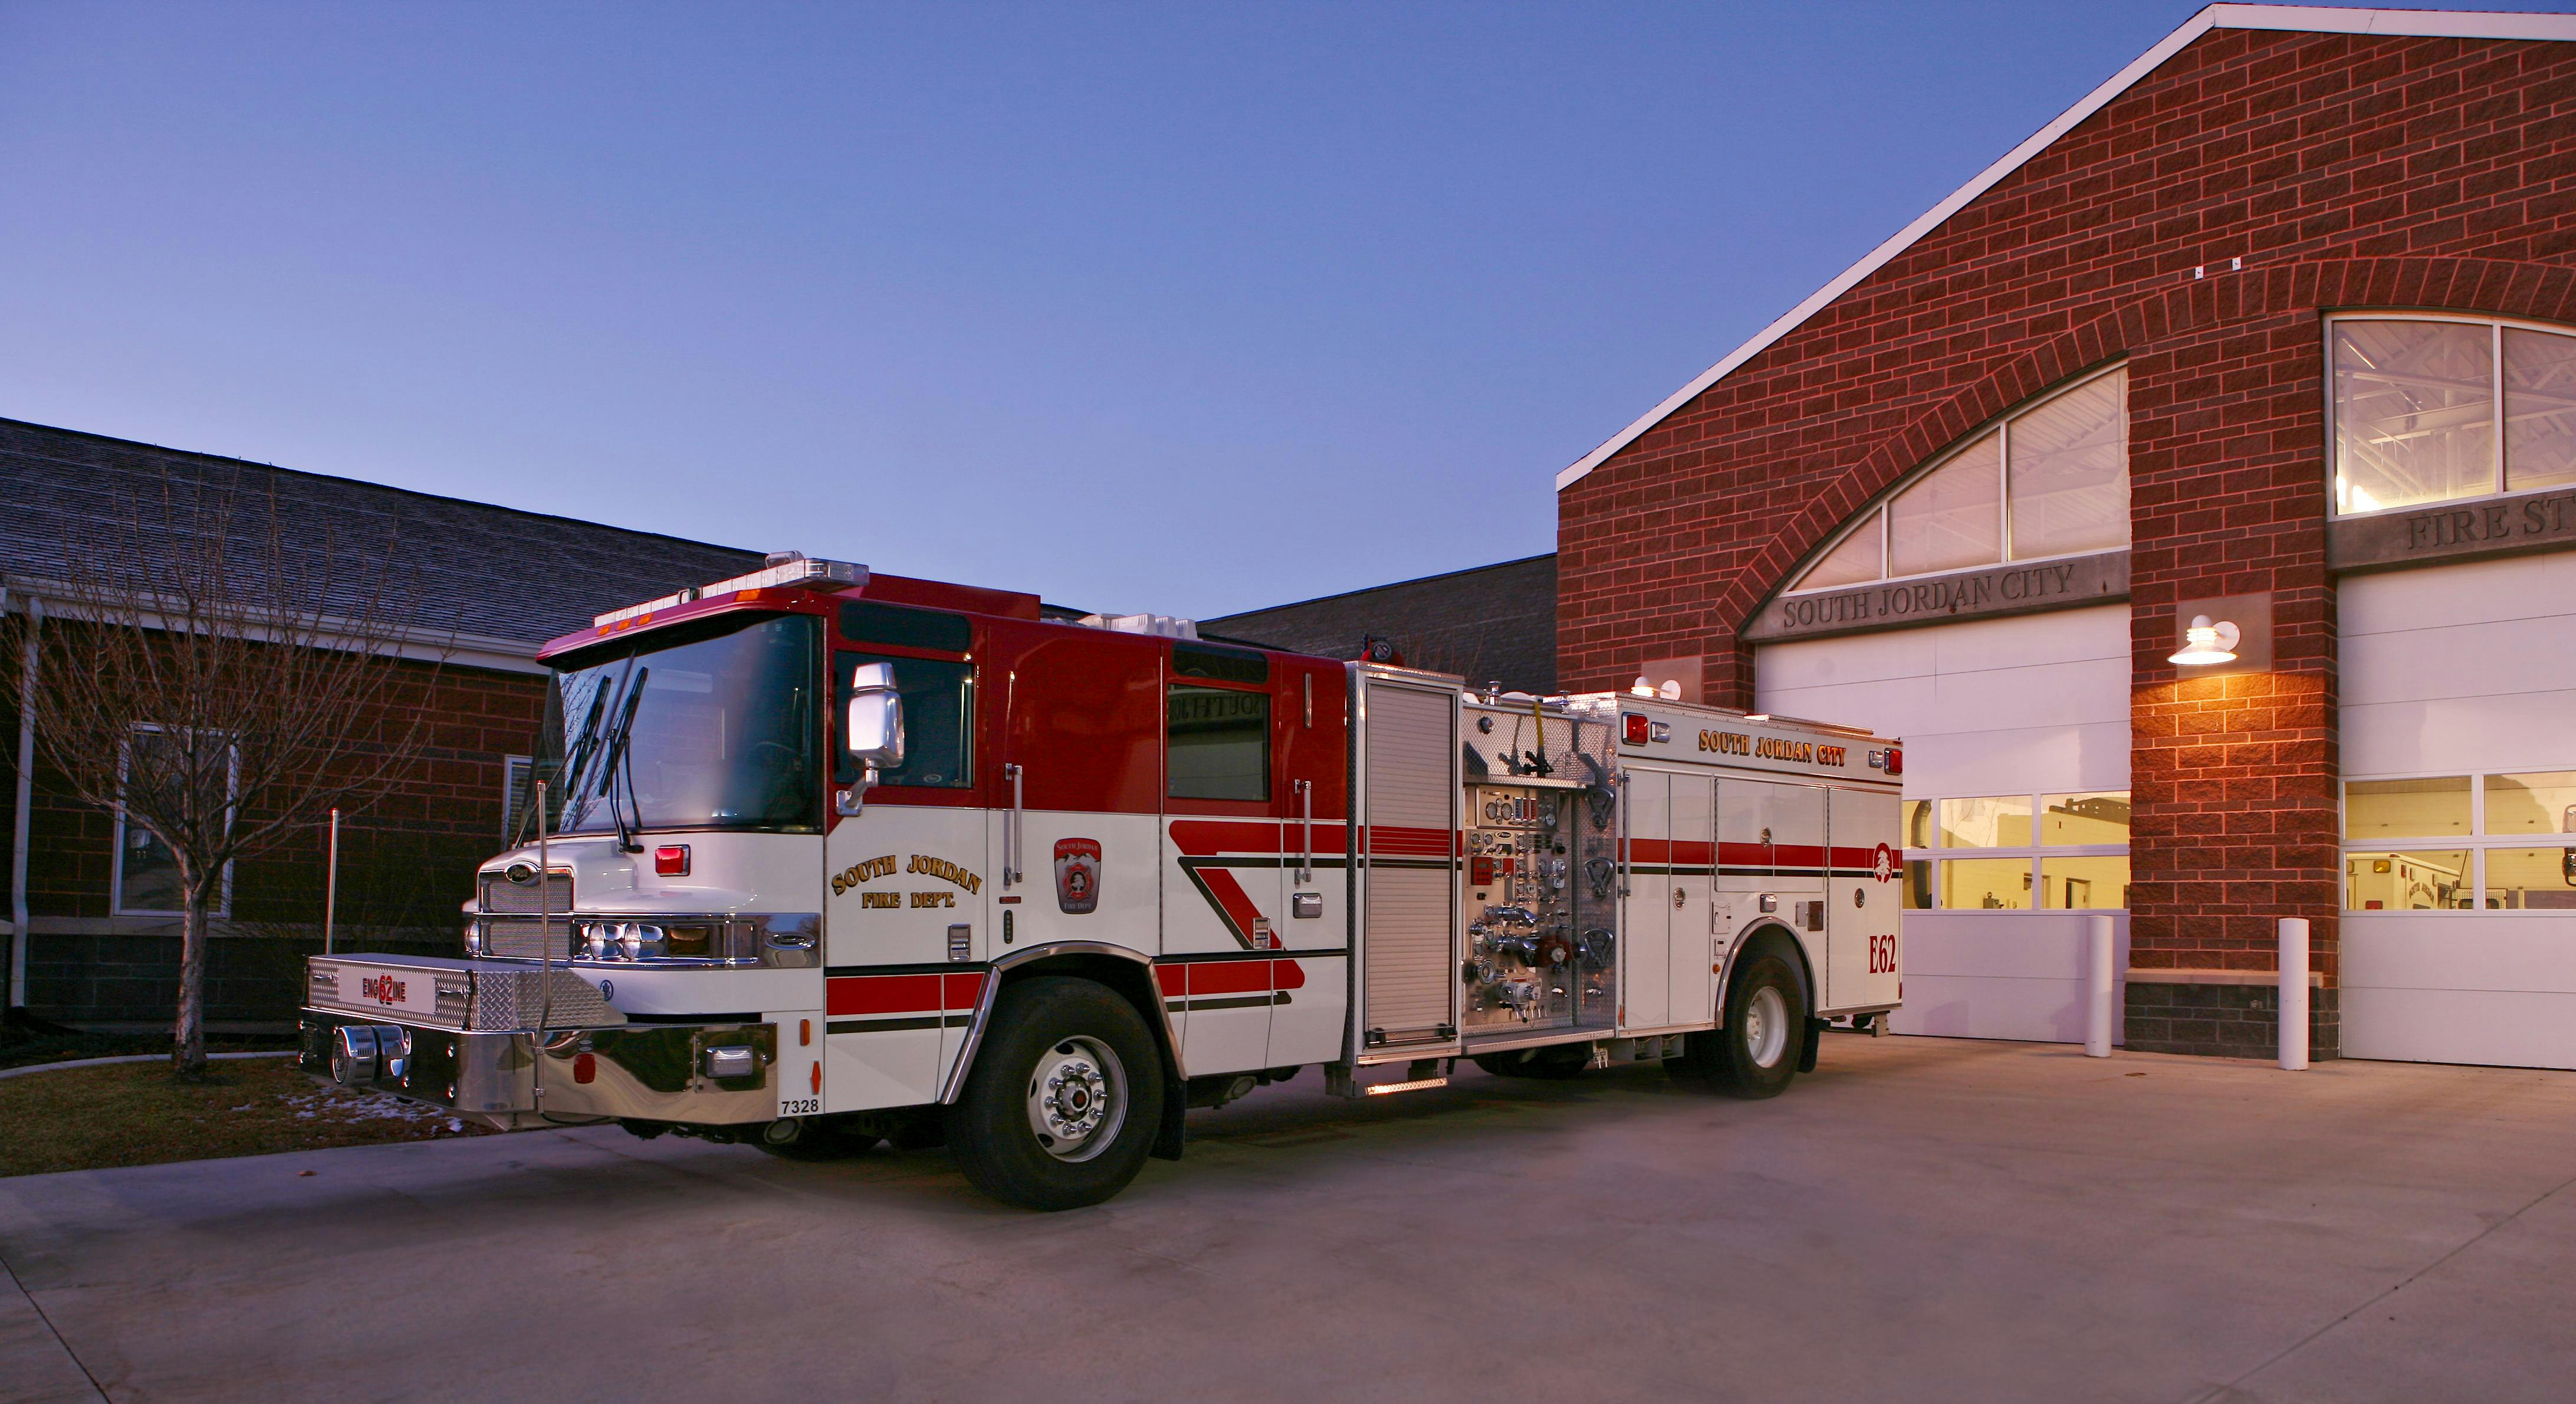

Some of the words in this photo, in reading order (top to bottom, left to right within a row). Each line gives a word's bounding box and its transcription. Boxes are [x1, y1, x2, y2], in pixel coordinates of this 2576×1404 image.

[2407, 505, 2509, 550] FIRE
[2524, 496, 2576, 535] ST
[1783, 592, 1871, 628] SOUTH
[1878, 575, 1992, 615] JORDAN
[2000, 564, 2075, 600] CITY
[1699, 729, 1750, 756] SOUTH
[1755, 737, 1812, 763] JORDAN
[1817, 744, 1846, 767] CITY
[832, 855, 896, 897] SOUTH
[906, 854, 982, 895] JORDAN
[862, 892, 901, 908] FIRE
[911, 891, 956, 908] DEPT.
[1869, 934, 1896, 974] E62
[781, 1099, 819, 1114] 7328
